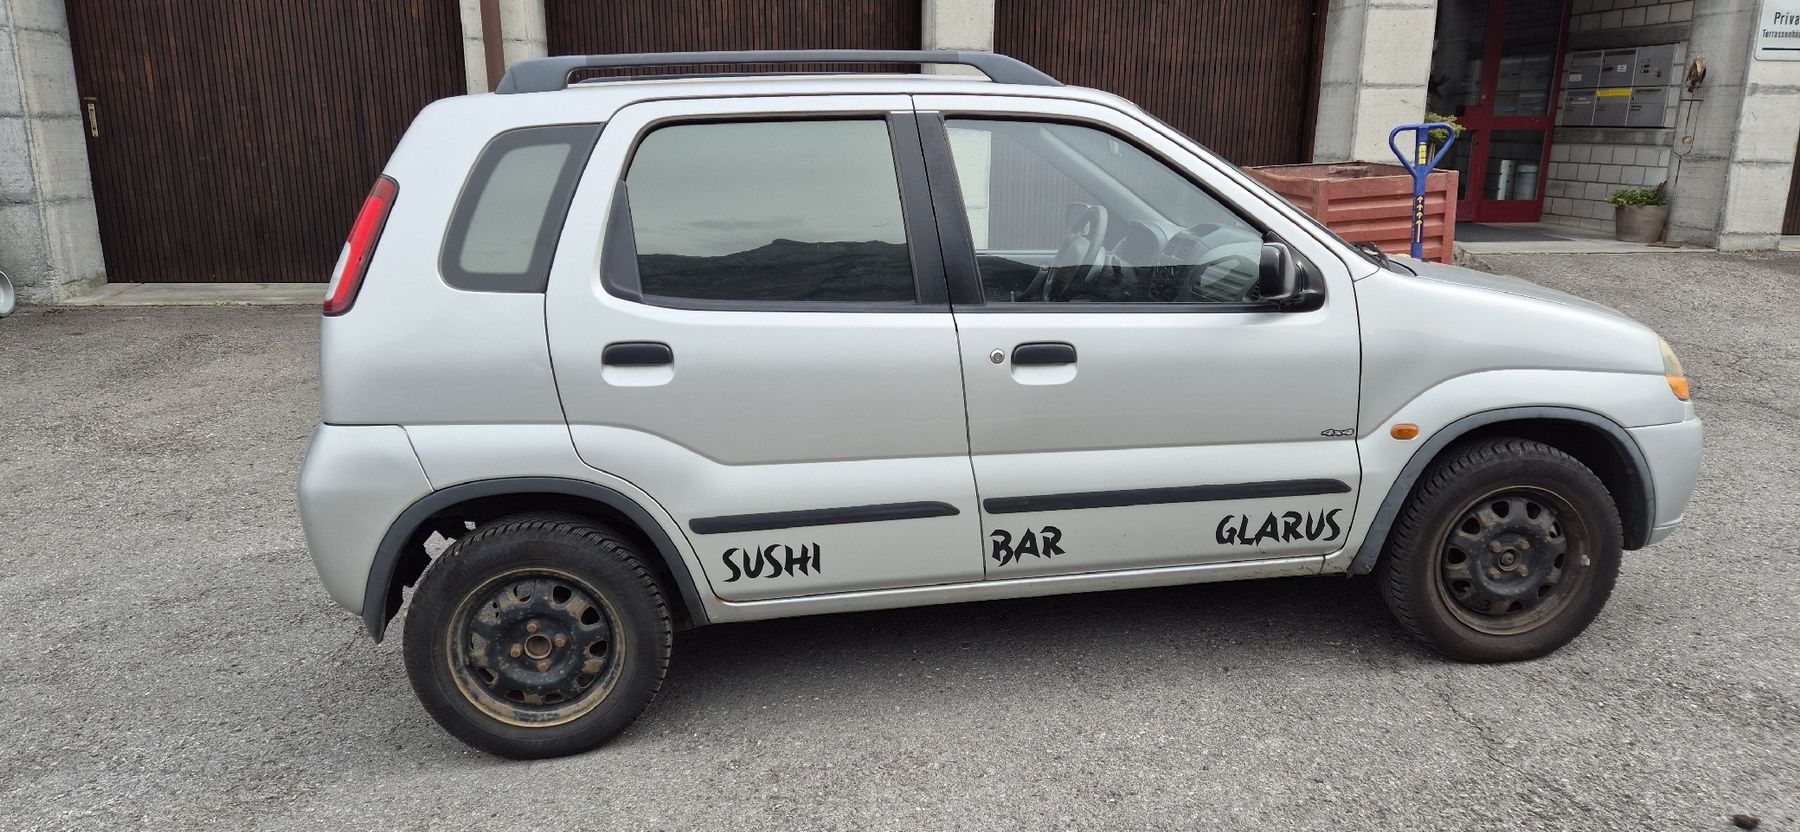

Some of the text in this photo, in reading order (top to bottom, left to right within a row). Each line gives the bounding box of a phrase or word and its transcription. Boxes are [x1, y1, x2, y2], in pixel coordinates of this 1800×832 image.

[722, 508, 1343, 583] SUSHI BAR GLARUS
